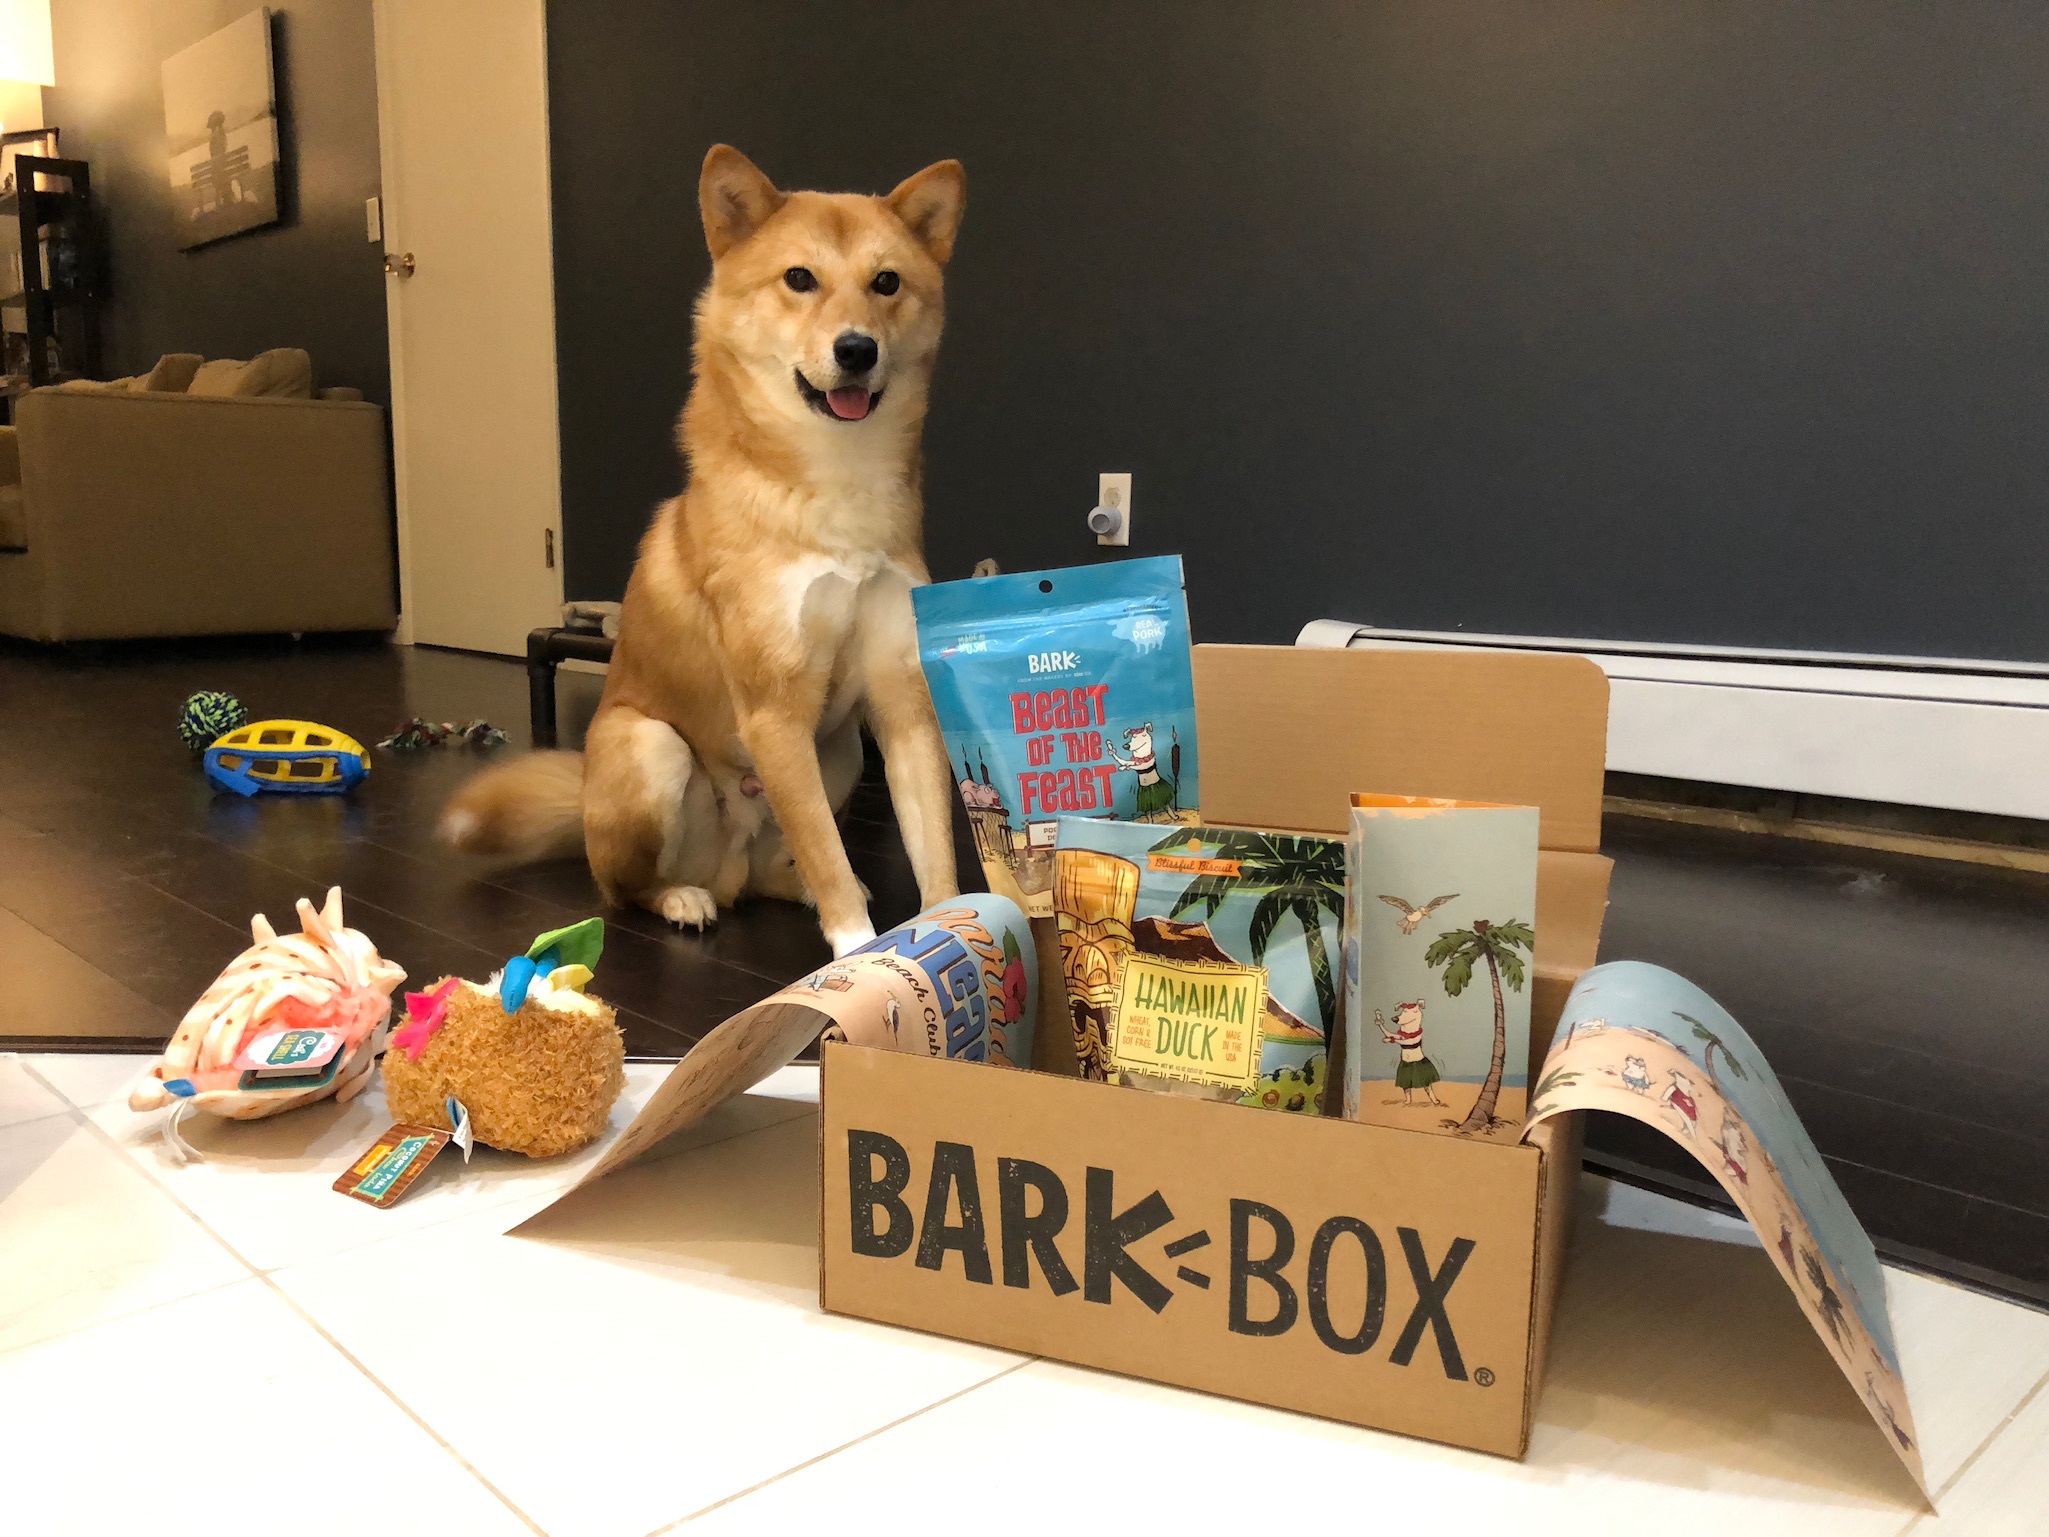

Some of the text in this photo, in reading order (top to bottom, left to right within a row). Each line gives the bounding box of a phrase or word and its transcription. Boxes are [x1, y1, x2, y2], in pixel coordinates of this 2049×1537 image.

[1135, 617, 1159, 630] REAL
[1132, 626, 1163, 641] PORK
[1028, 650, 1076, 674] BARK
[1026, 734, 1055, 767] OF
[1155, 857, 1234, 873] Blissful Biscuit
[1134, 972, 1248, 1025] HAWAIIAN
[871, 957, 942, 1057] Beach Club
[1126, 1025, 1144, 1037] CORN
[1226, 1030, 1242, 1041] MADE
[1122, 1036, 1152, 1049] SOY FREE
[1154, 1016, 1219, 1063] DUCK
[1222, 1041, 1243, 1052] IN THE
[1225, 1053, 1237, 1062] USA
[390, 1141, 422, 1173] COCONUT
[848, 1128, 1175, 1315] BARK
[1228, 1198, 1477, 1382] BOX
